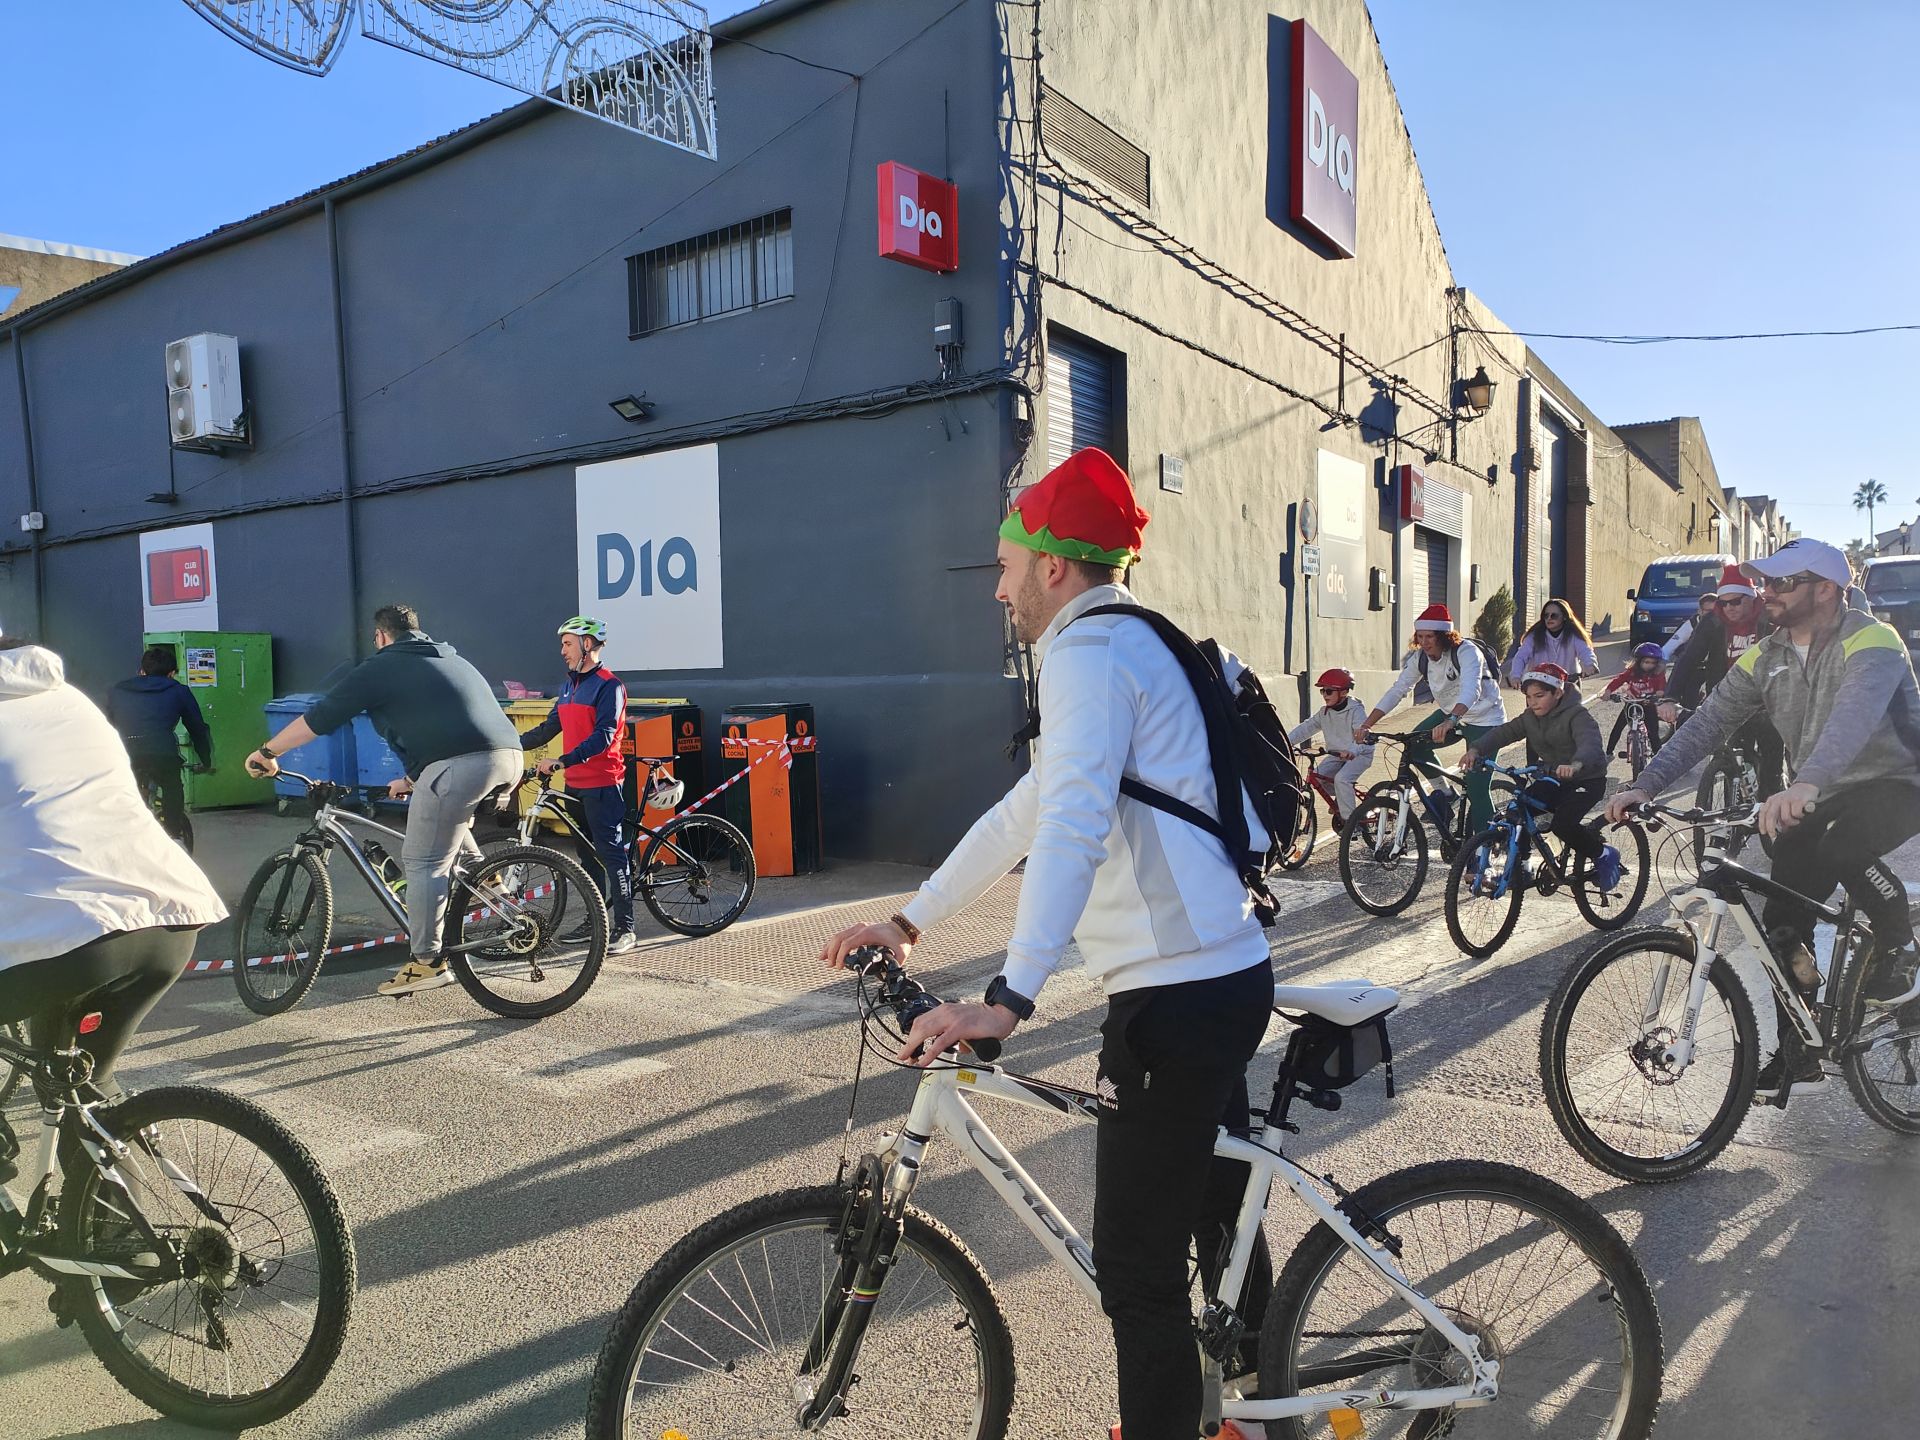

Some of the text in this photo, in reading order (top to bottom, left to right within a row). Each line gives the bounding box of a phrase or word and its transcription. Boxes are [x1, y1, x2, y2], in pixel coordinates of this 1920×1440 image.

[1308, 87, 1353, 197] Dia
[900, 195, 942, 238] Dia
[597, 532, 698, 600] Dia
